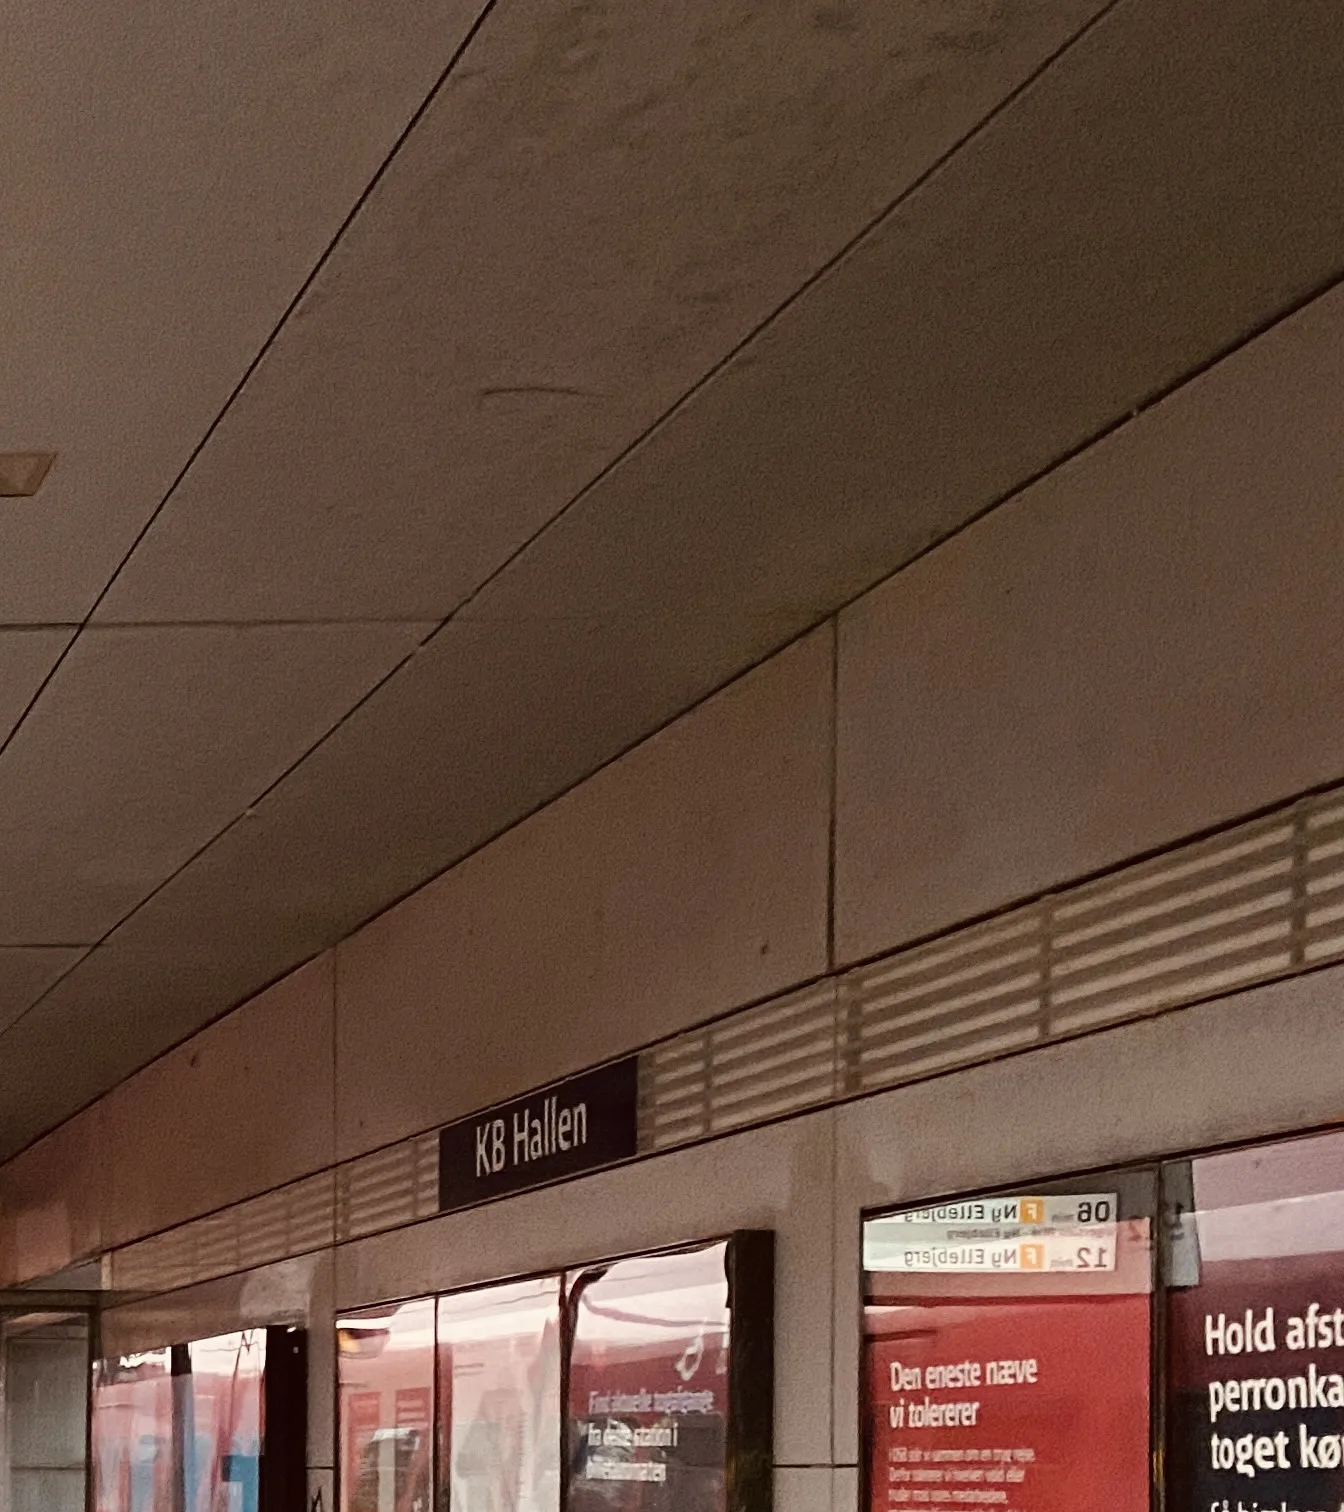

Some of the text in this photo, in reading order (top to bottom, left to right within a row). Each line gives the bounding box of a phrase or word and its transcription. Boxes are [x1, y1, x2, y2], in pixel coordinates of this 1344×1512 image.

[476, 1096, 587, 1178] KB Hallen
[1205, 1303, 1344, 1356] Hold afst
[890, 1358, 1038, 1392] Den eneste næve
[1208, 1362, 1344, 1423] perronka
[889, 1396, 980, 1428] vi tolererer
[1210, 1422, 1344, 1478] toget kø
